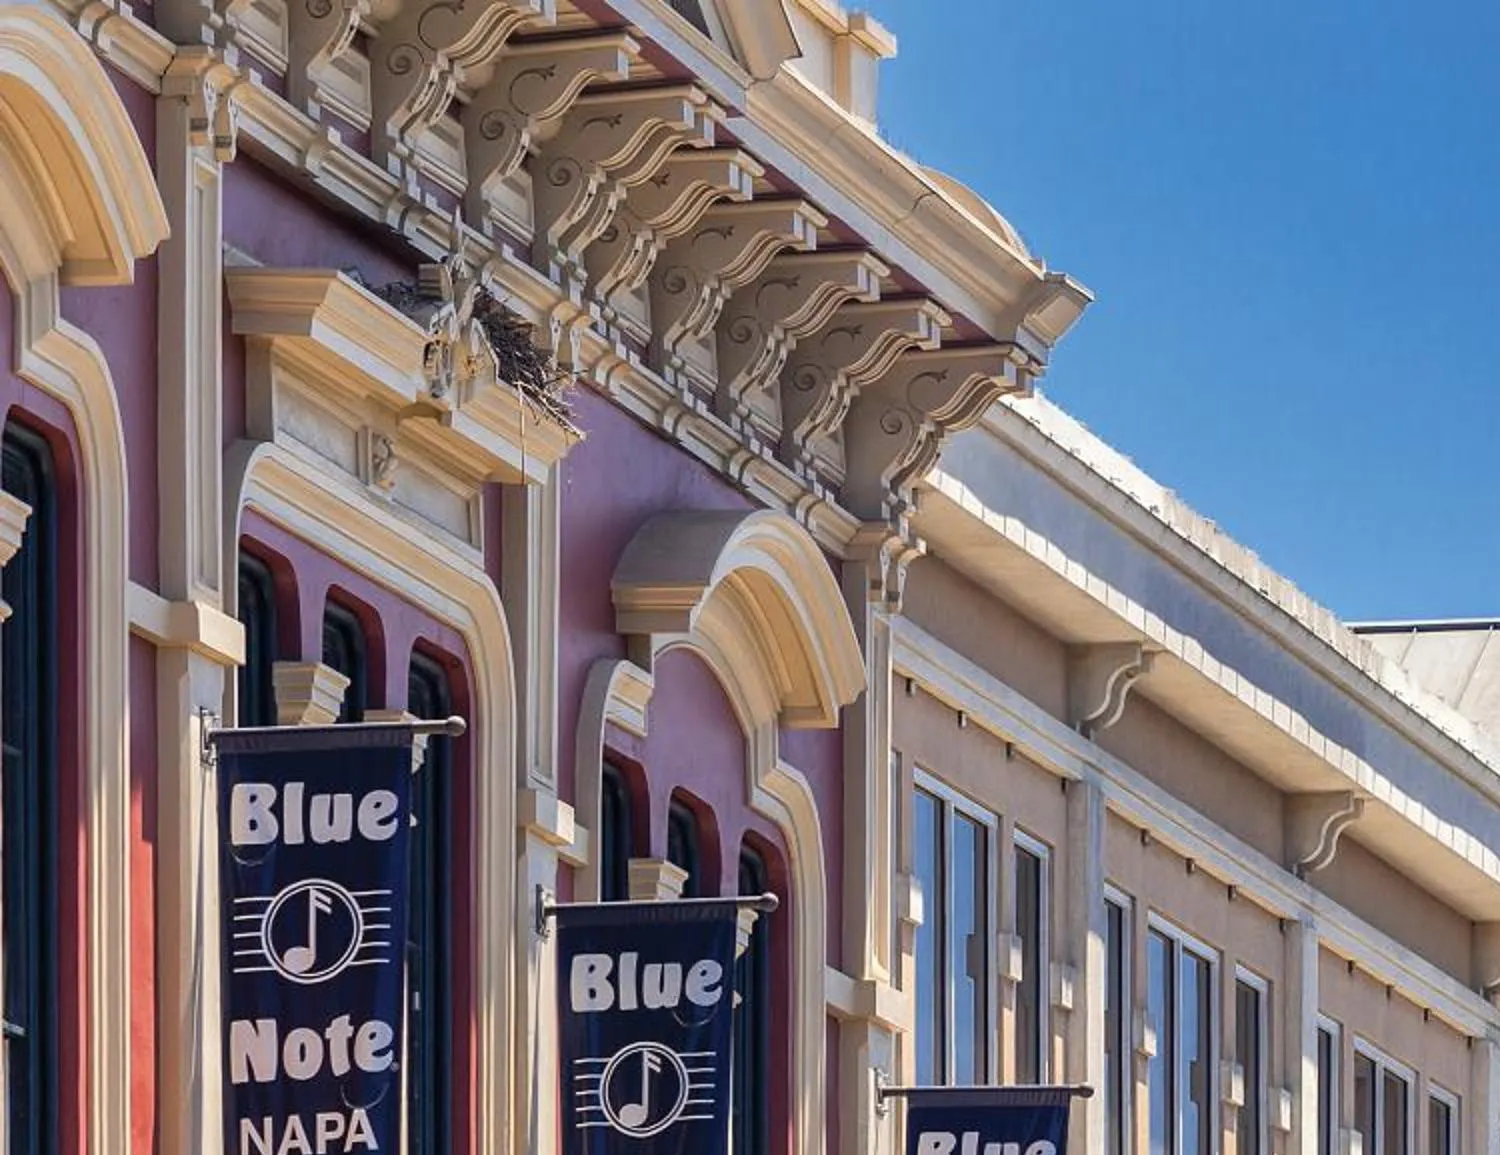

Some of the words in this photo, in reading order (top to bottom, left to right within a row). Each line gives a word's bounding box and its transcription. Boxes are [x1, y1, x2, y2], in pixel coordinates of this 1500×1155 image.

[231, 781, 399, 845] Blue
[571, 951, 723, 1012] Blue
[229, 1013, 395, 1084] Note
